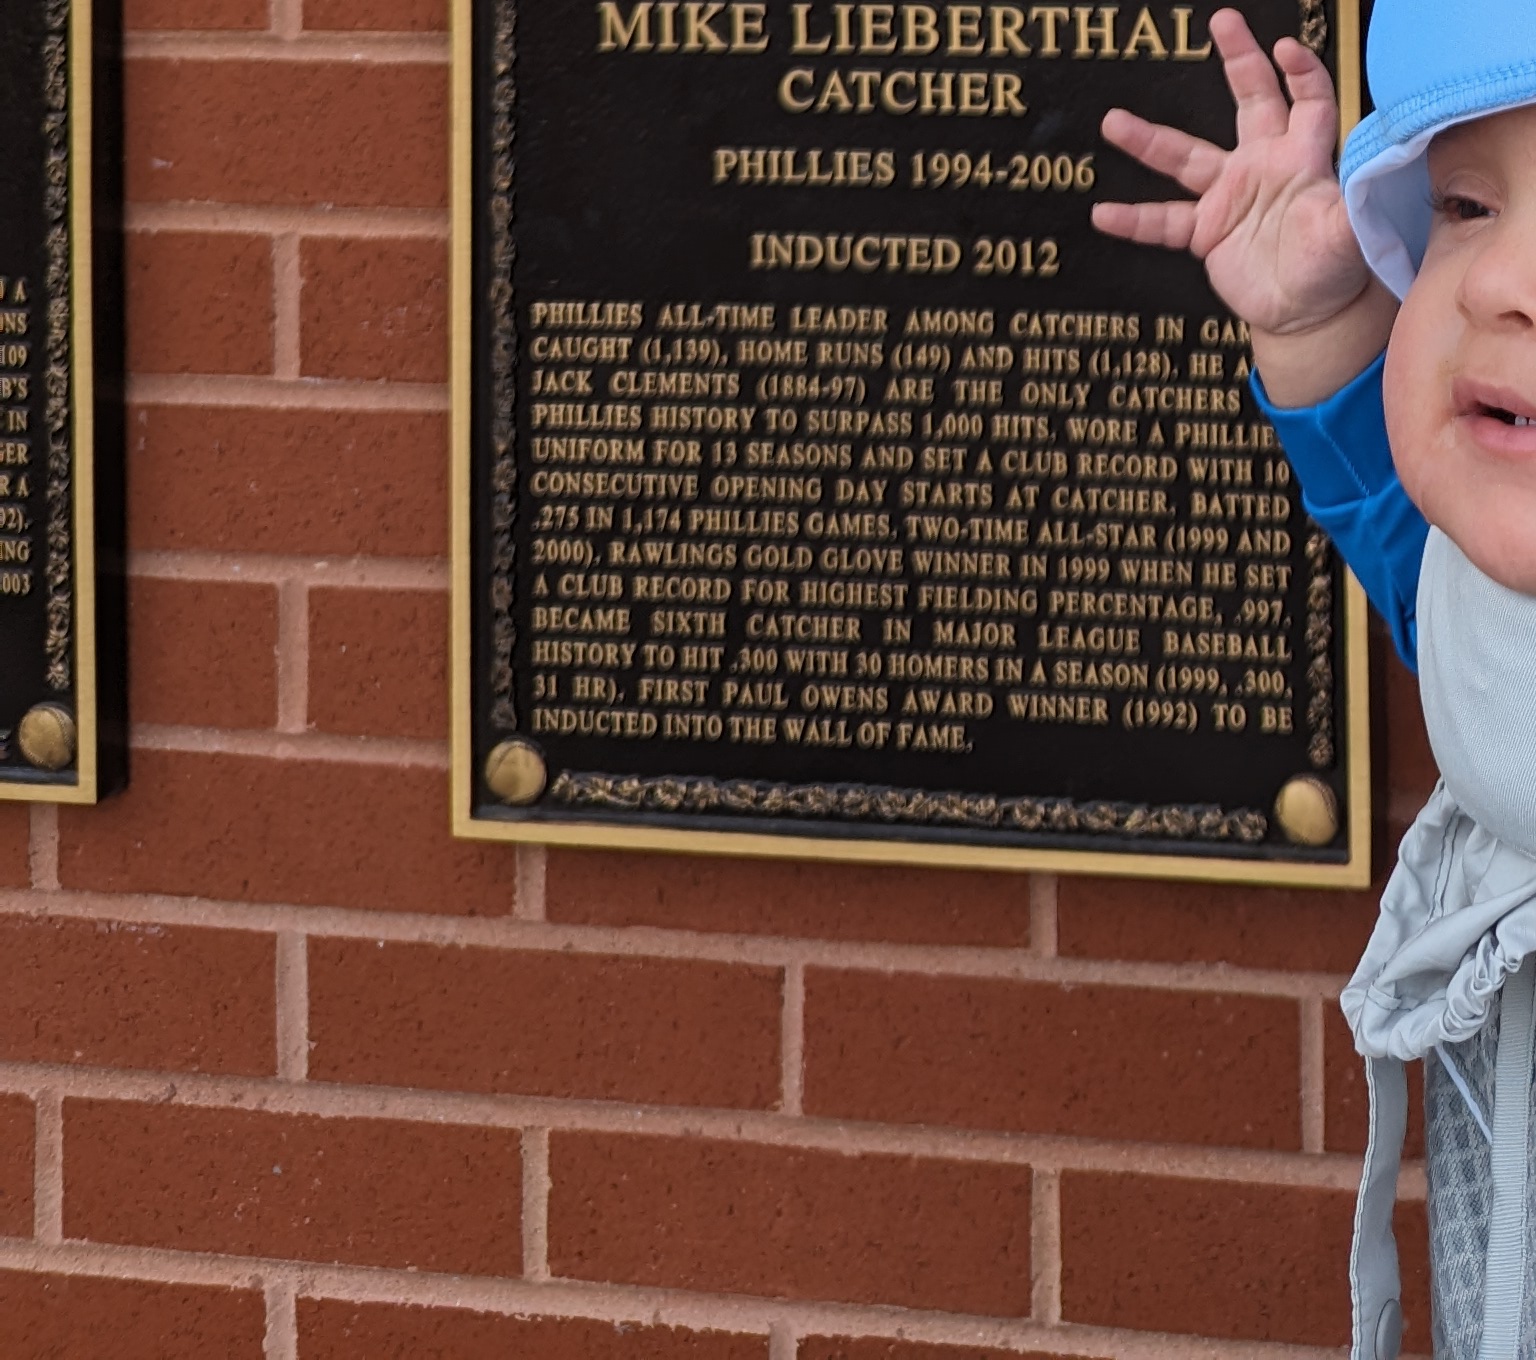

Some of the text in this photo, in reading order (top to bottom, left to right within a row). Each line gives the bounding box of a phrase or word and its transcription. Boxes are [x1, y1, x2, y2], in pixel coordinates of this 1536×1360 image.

[599, 1, 1212, 58] MIKE LIEBERTHAL
[780, 69, 1026, 114] CATCHER
[715, 148, 1095, 188] PHILLIES 1994-2006
[752, 233, 1060, 275] INDUCTED 2012
[531, 435, 1290, 484] UNIFORM FOR 13 SEASONS AND SET A CLUB RECORD WITH 10
[529, 469, 698, 499] CONSECUTIVE
[710, 473, 822, 501] OPENING
[835, 477, 887, 504] DAY
[900, 479, 993, 508] STARTS
[1005, 483, 1040, 510] AT
[1190, 490, 1290, 520] BATTED
[531, 605, 1291, 661] BECAME SIXTH CATCHER IN MAJOR LEAGUE BASEBALL
[532, 706, 658, 736] INDUCTED
[663, 711, 723, 738] INTO
[727, 714, 776, 741] THE
[783, 717, 852, 745] WALL
[856, 720, 891, 746] OF
